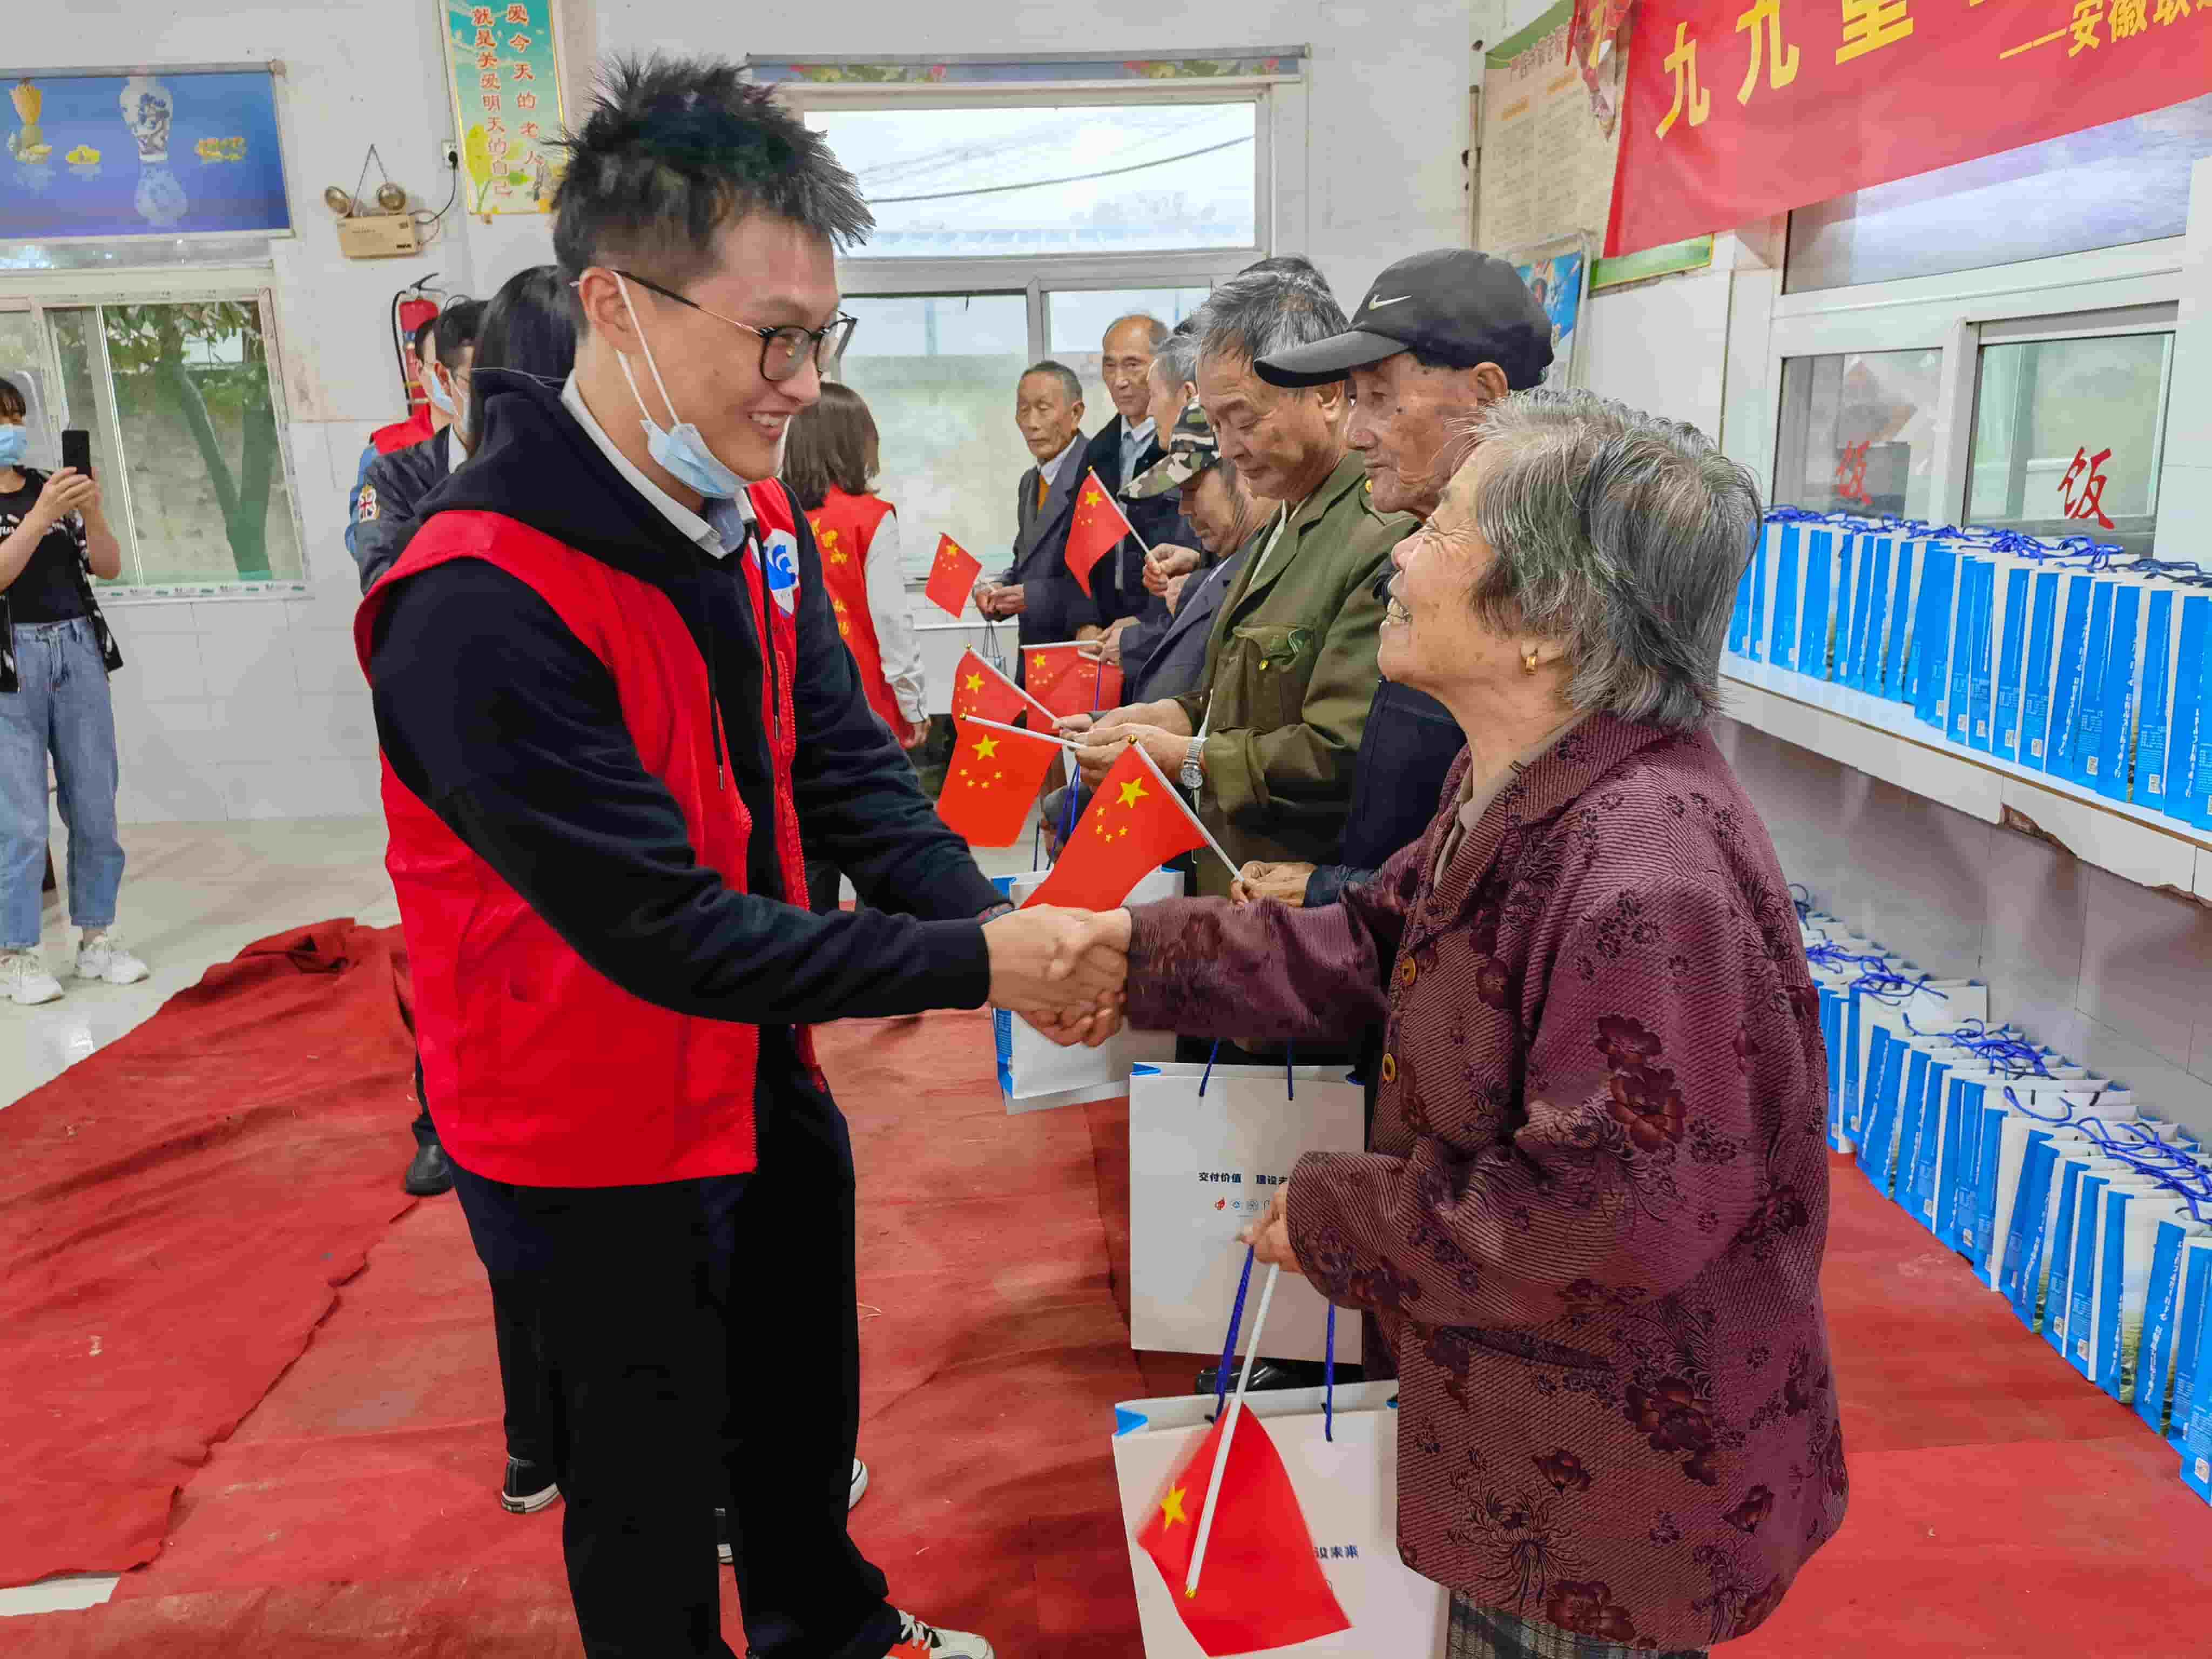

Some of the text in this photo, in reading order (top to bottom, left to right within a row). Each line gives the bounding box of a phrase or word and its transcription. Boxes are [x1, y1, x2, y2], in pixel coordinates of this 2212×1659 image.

[1655, 0, 1987, 138] 九九重
[2057, 447, 2115, 530] 饭
[1198, 1172, 1242, 1183] 交付价值
